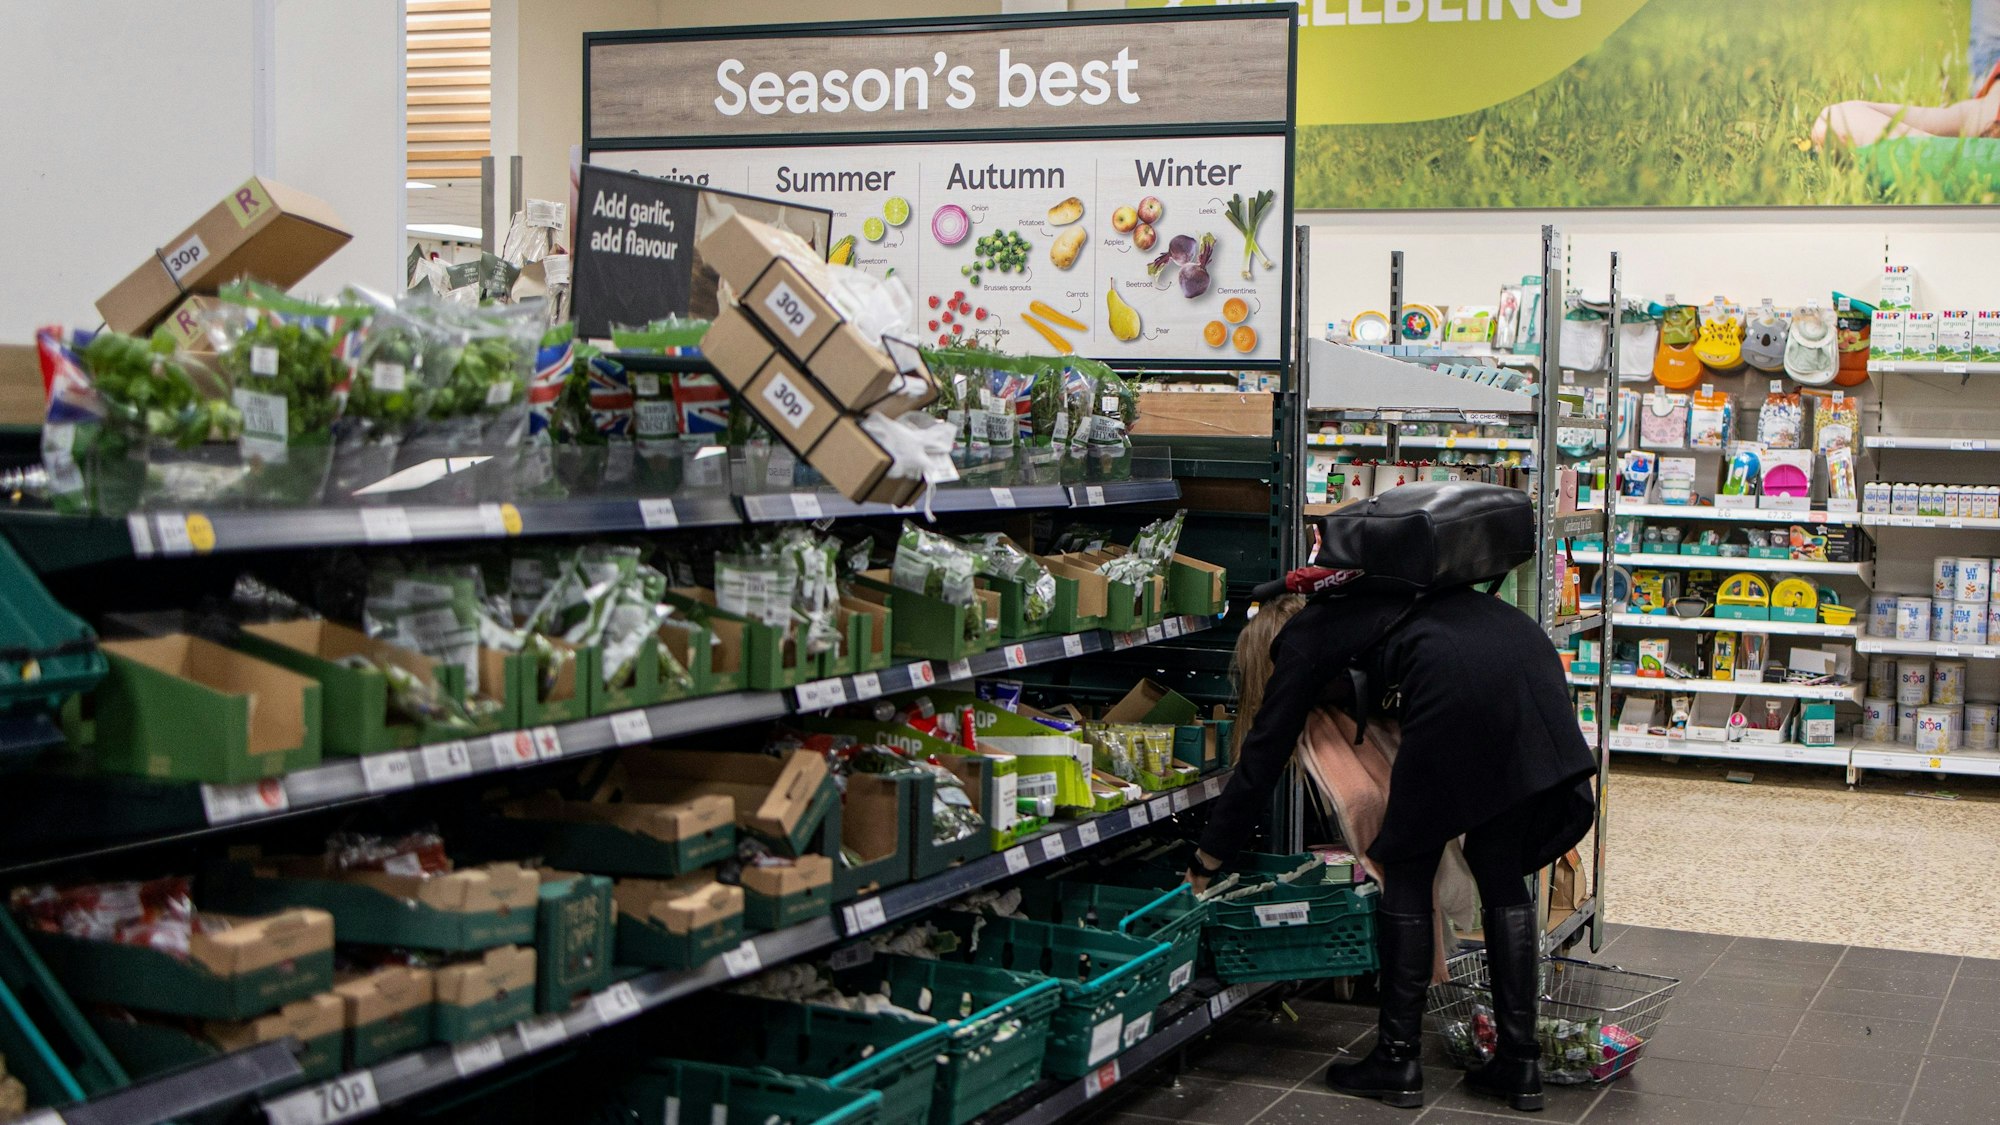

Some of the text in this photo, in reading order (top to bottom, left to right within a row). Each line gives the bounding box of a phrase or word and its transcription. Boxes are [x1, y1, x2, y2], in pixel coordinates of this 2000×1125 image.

[713, 46, 1141, 116] Season’s best
[775, 166, 896, 193] Summer
[946, 162, 1065, 190] Autumn
[1134, 158, 1242, 188] Winter
[235, 187, 260, 214] R
[592, 190, 627, 220] Add
[629, 199, 675, 233] garlic,
[971, 204, 989, 212] Onion
[1198, 207, 1217, 215] Leeks
[1018, 219, 1045, 227] Potatoes
[590, 226, 678, 260] add flavour
[1104, 238, 1125, 248] Apples
[170, 246, 201, 271] 30p
[1885, 266, 1909, 274] HiPP
[983, 284, 1032, 294] Brussels sprouts
[1125, 280, 1153, 289] Beetroot
[1217, 287, 1257, 295] Clementines
[776, 292, 805, 325] 30p
[1876, 312, 1900, 320] HiPP
[175, 308, 198, 335] R
[1964, 331, 1970, 340] 2
[774, 383, 803, 416] 30p
[1548, 492, 1556, 540] Kids
[1717, 508, 1732, 518] £6
[1546, 550, 1556, 580] for
[1638, 616, 1652, 625] £5
[1920, 718, 1942, 732] sma
[314, 1081, 366, 1121] 70p
